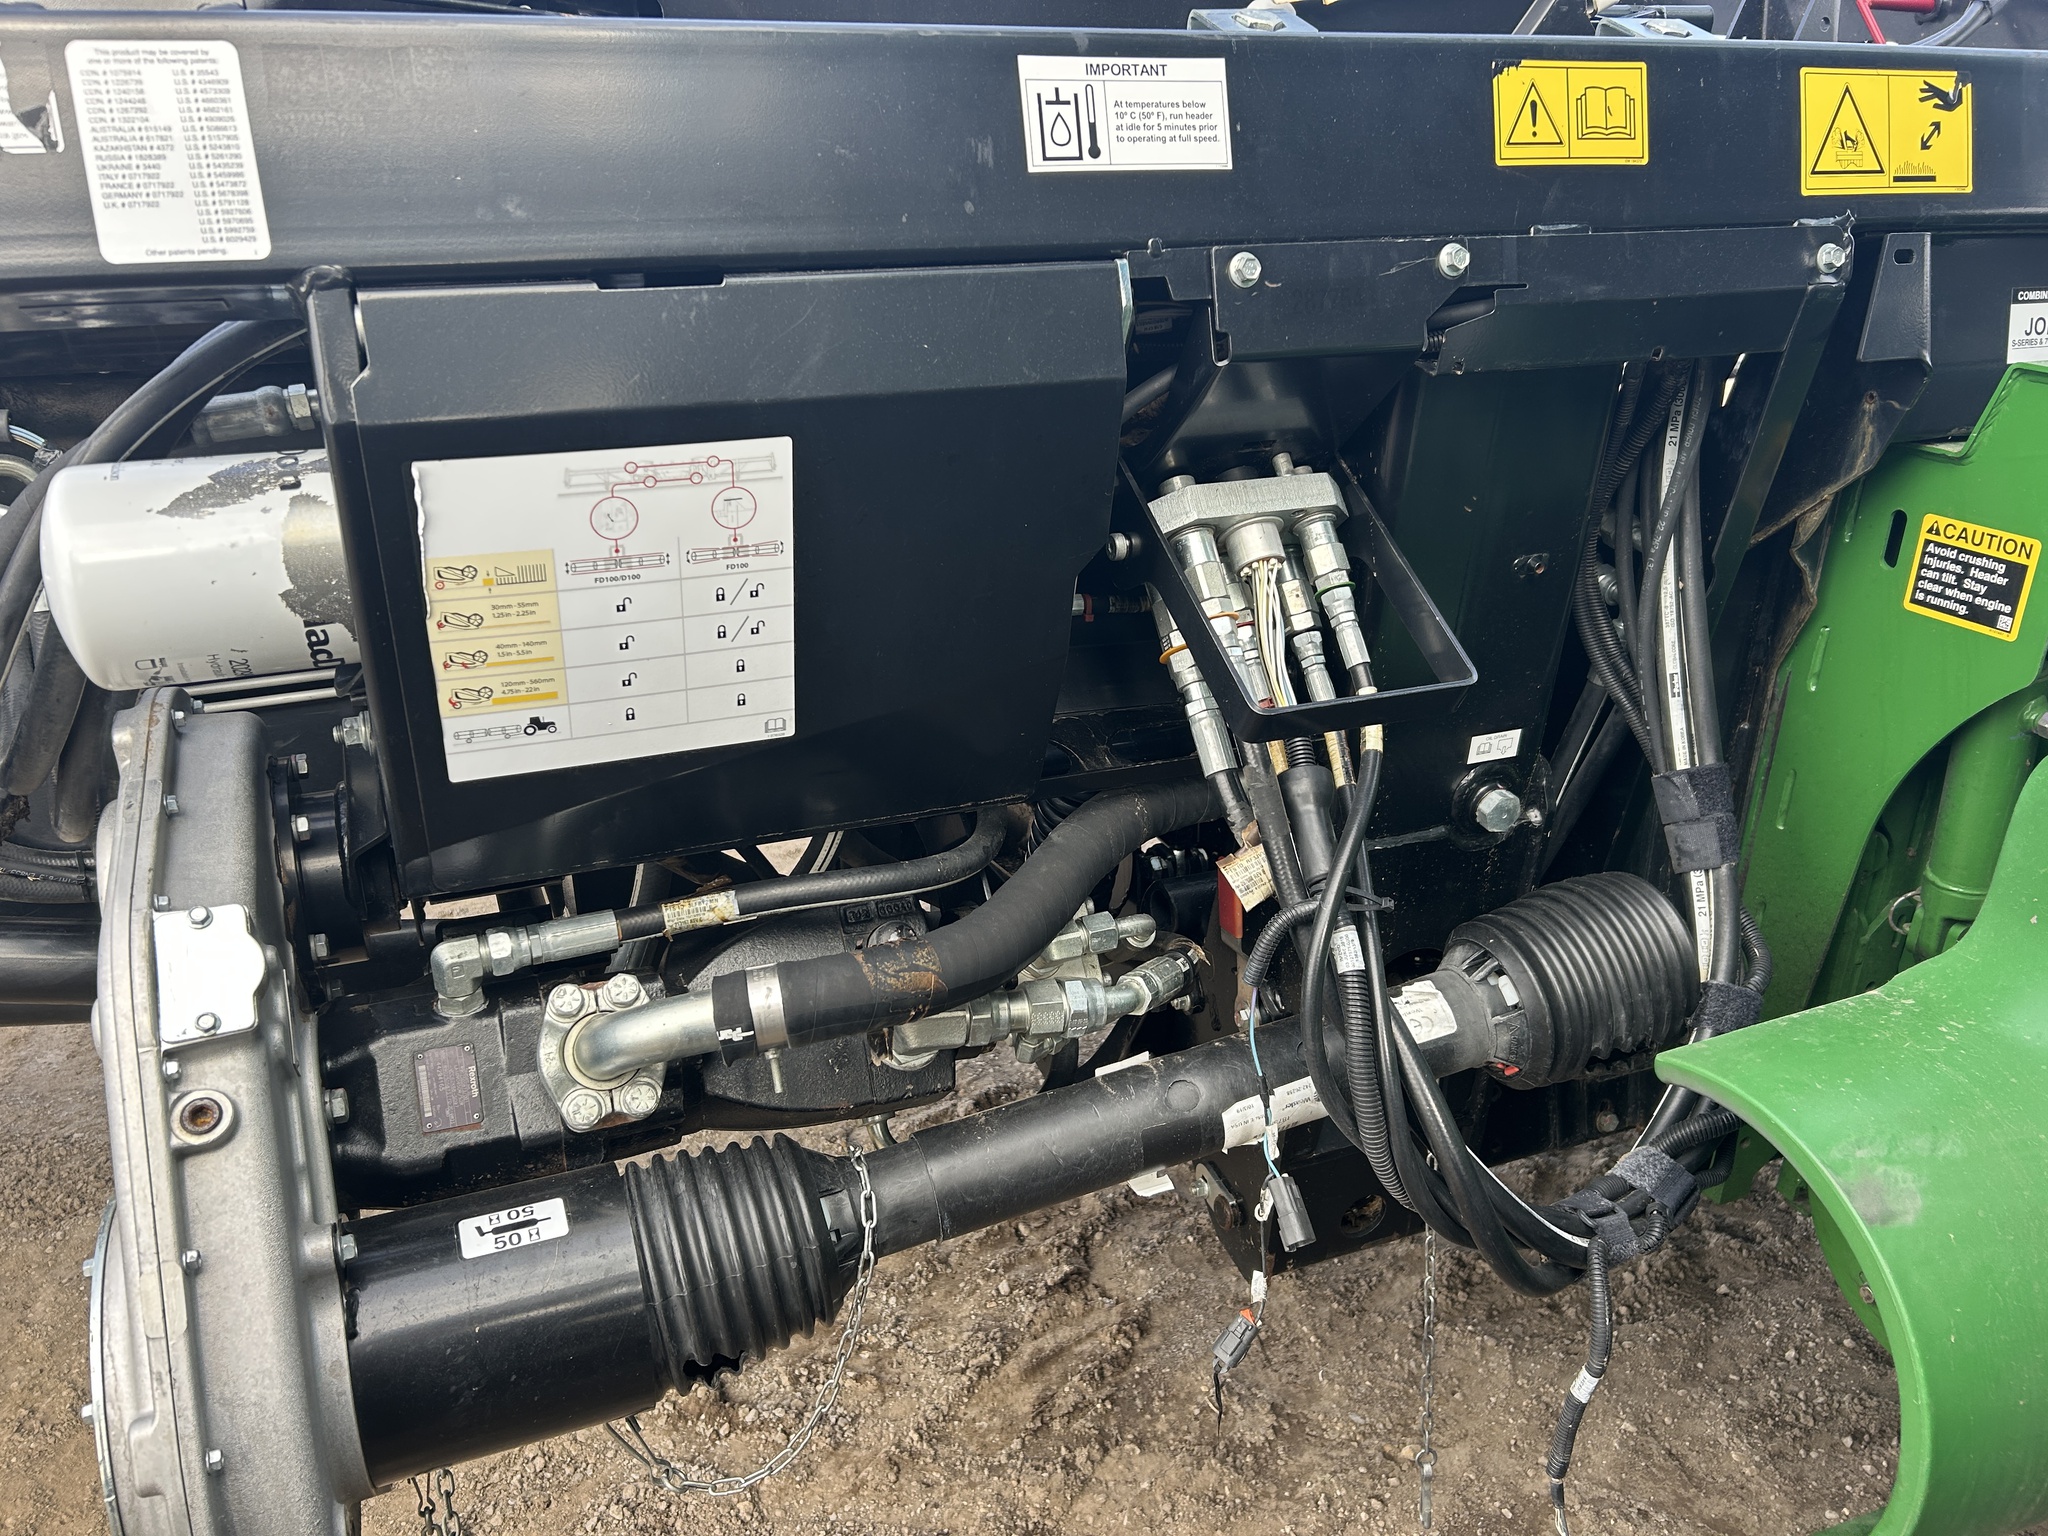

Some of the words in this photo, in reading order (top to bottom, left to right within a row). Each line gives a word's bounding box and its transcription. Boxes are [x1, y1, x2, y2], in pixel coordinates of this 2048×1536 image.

[1085, 63, 1168, 77] IMPORTANT
[1125, 101, 1180, 109] temperatures
[1115, 112, 1128, 120] 10°
[1139, 111, 1155, 121] (50°
[1157, 112, 1168, 121] F),
[1185, 112, 1212, 120] header
[1126, 123, 1141, 131] idle
[1143, 123, 1154, 131] for
[1157, 123, 1162, 131] 5
[1164, 123, 1196, 131] minutes
[1198, 123, 1217, 133] prior
[1116, 135, 1125, 143] to
[1127, 135, 1167, 144] operating
[1193, 135, 1220, 144] speed.
[145, 248, 166, 256] Other
[169, 248, 195, 257] patents
[2024, 316, 2048, 336] JO
[2012, 338, 2038, 347] S-SERIES
[2039, 338, 2044, 346] &
[1670, 410, 1682, 432] MPa
[1668, 434, 1678, 447] 21
[1943, 523, 2034, 560] CAUTION
[1926, 543, 1958, 559] Avoid
[1959, 553, 2006, 574] crushing
[726, 562, 749, 570] FD100
[1923, 555, 1964, 574] injuries.
[1970, 567, 2009, 586] Header
[594, 573, 641, 584] FD100/D100
[1921, 568, 1939, 580] can
[1941, 572, 1958, 585] tilt.
[1963, 579, 1988, 595] Stay
[1915, 590, 1925, 601] is
[1926, 594, 1969, 615] running.
[1918, 579, 1943, 594] clear
[1945, 587, 1973, 603] when
[1975, 596, 2012, 614] engine
[1695, 880, 1706, 902] MPa
[1698, 906, 1707, 917] 21
[468, 1066, 479, 1098] Rexroth
[507, 1206, 534, 1220] 50
[494, 1232, 522, 1250] 50
